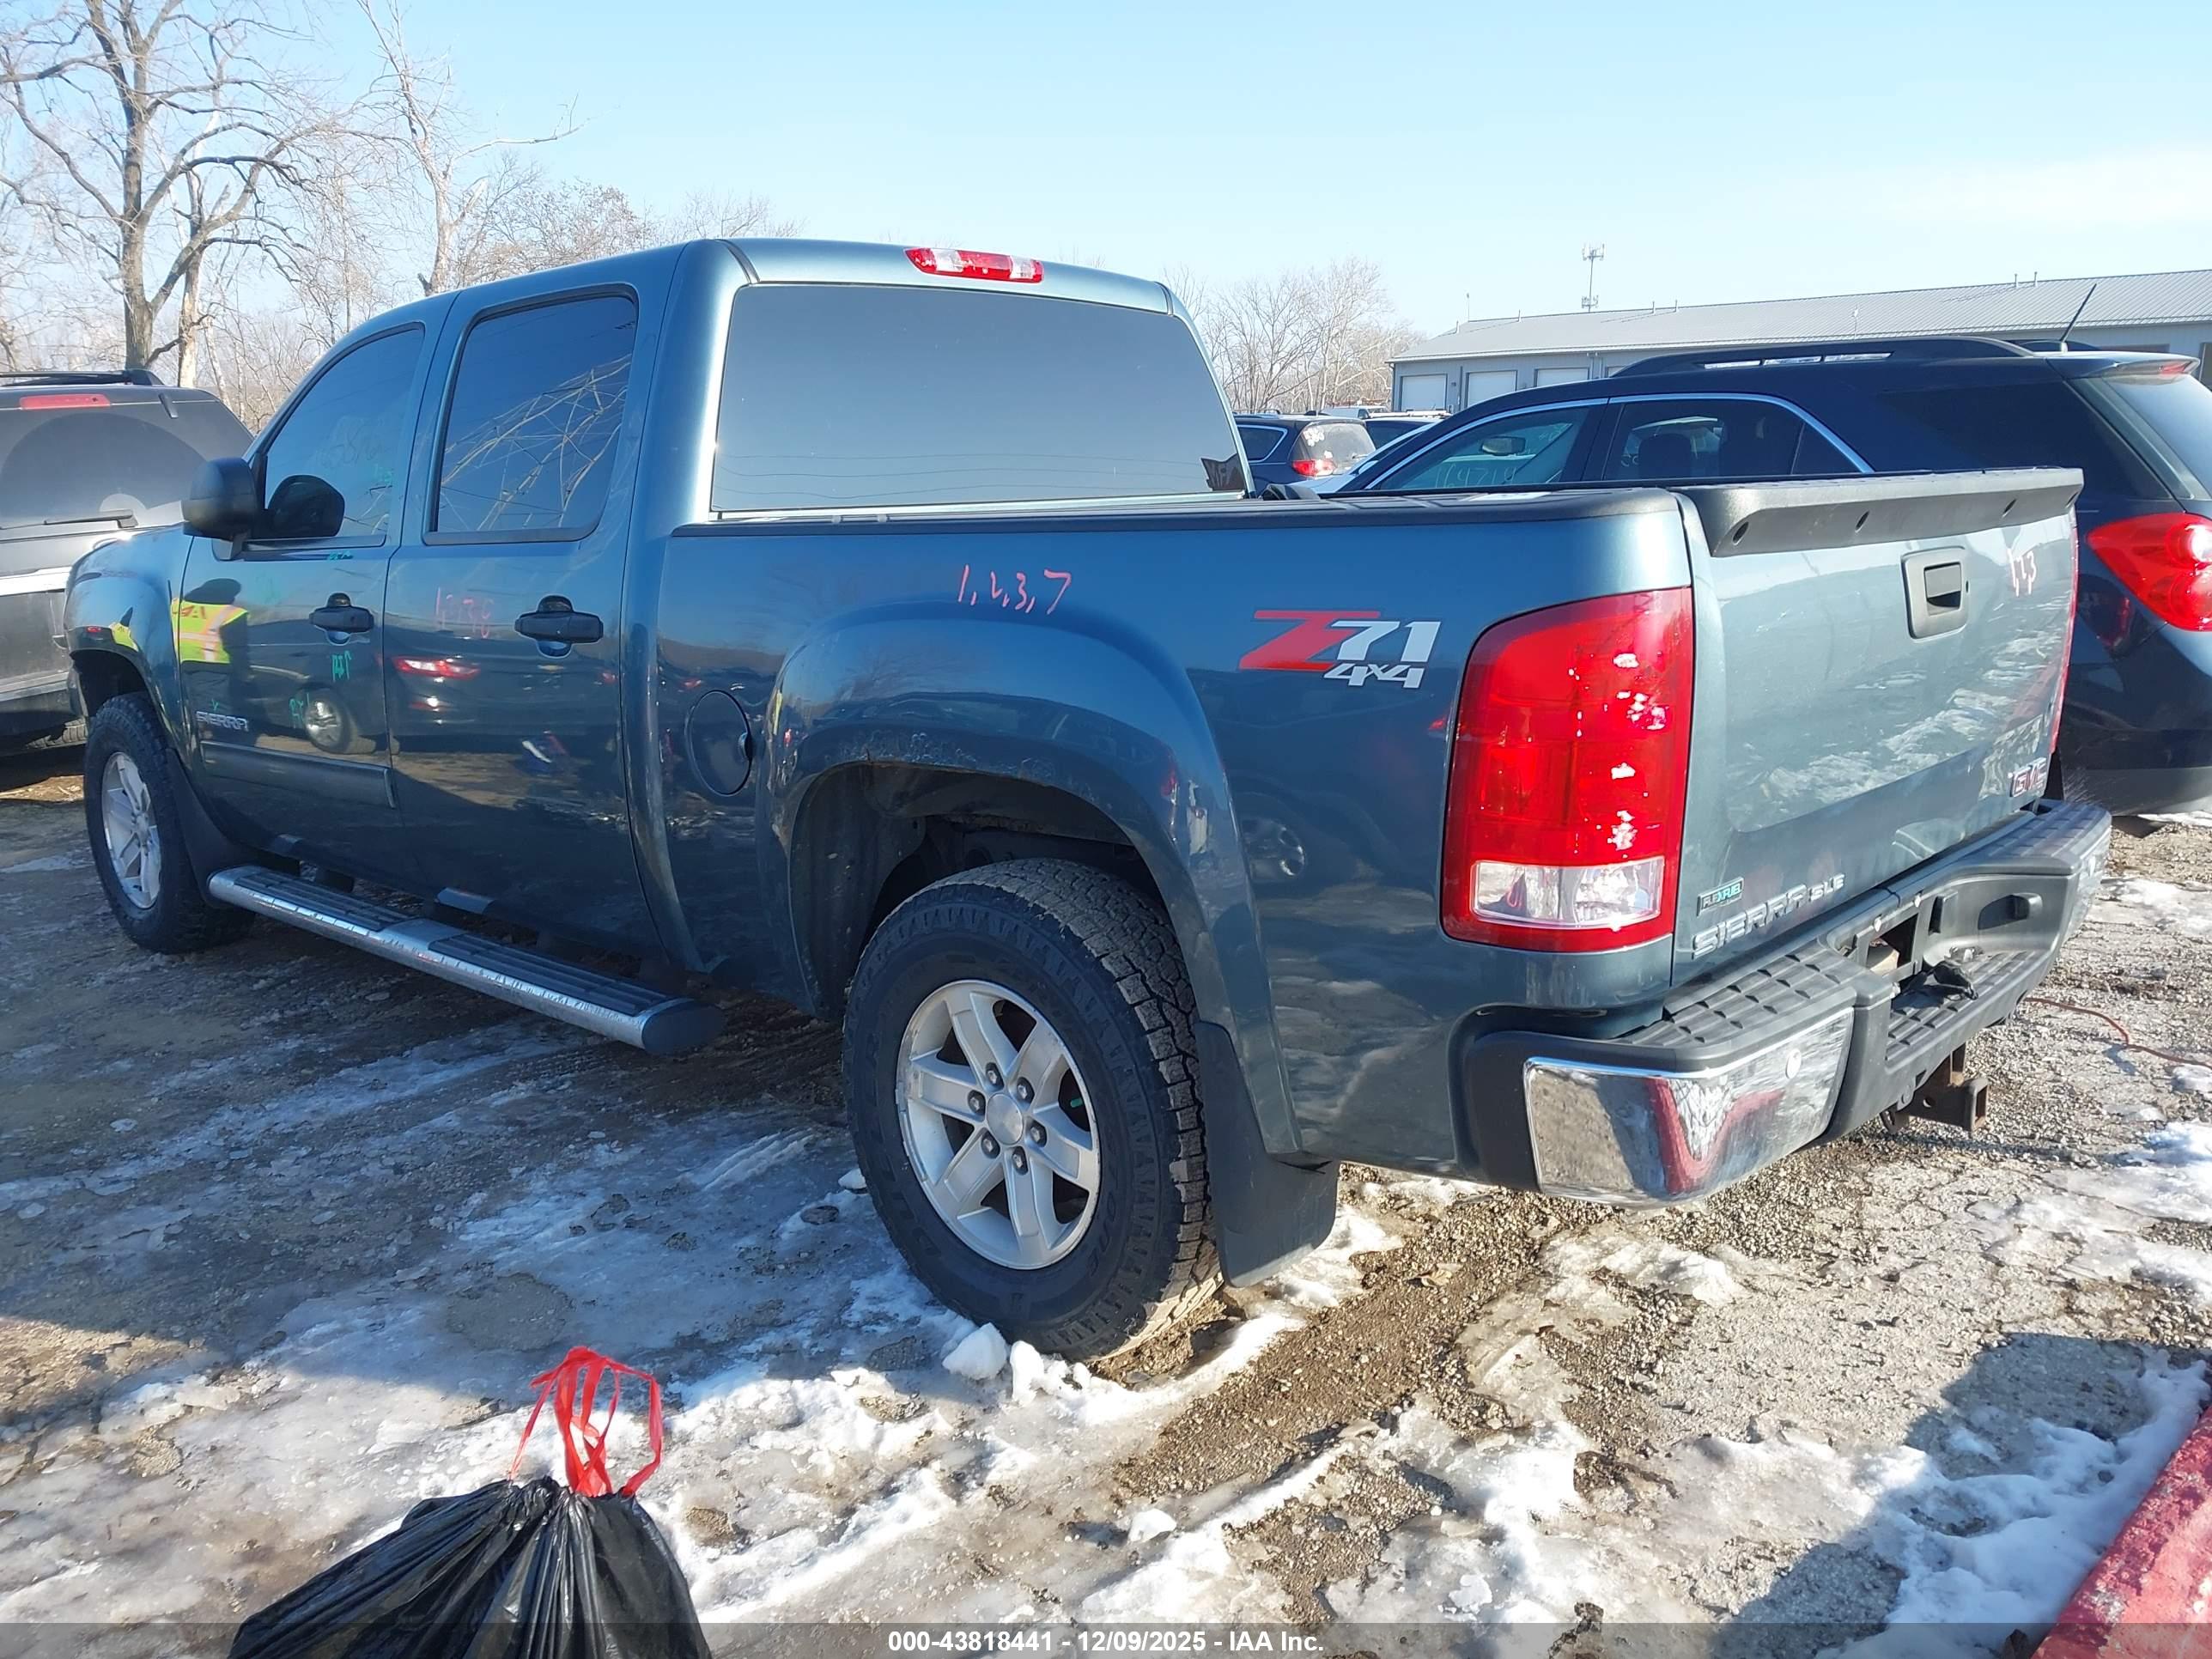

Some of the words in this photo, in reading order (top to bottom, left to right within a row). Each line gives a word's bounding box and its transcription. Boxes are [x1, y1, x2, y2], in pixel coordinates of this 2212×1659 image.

[1238, 610, 1442, 671] Z71
[195, 711, 249, 732] SIERRA
[1692, 884, 1807, 960] SIERRA
[1809, 873, 1845, 902] SLE
